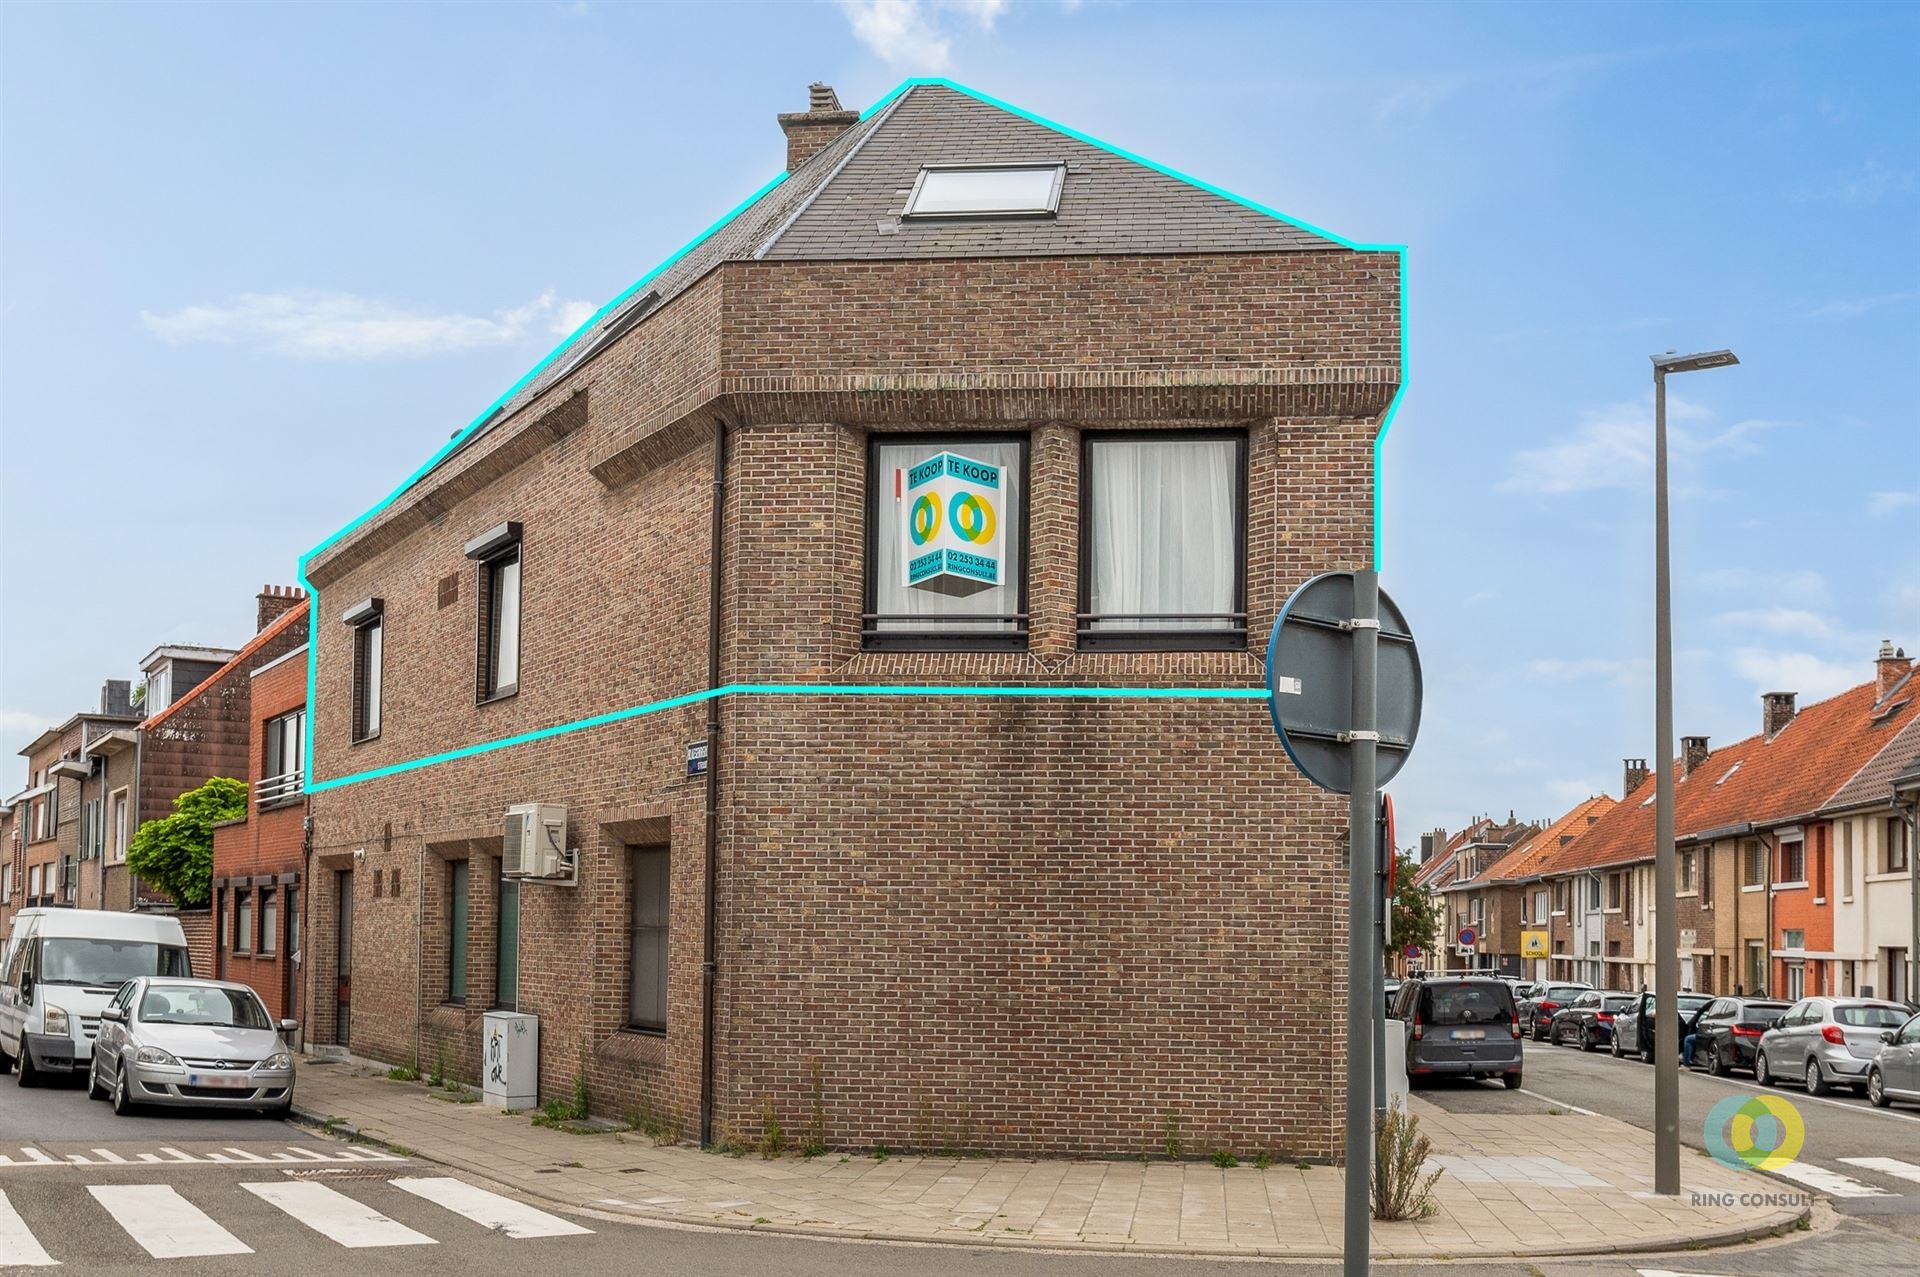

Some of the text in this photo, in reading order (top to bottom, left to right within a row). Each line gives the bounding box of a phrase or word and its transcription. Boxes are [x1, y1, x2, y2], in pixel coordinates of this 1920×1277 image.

[909, 460, 943, 485] TE KOOP
[948, 460, 998, 483] TE KOOP
[910, 562, 917, 571] 02
[917, 558, 927, 568] 253
[948, 551, 996, 569] 02 253 34 44
[947, 563, 996, 580] RINGCONSULT.BE
